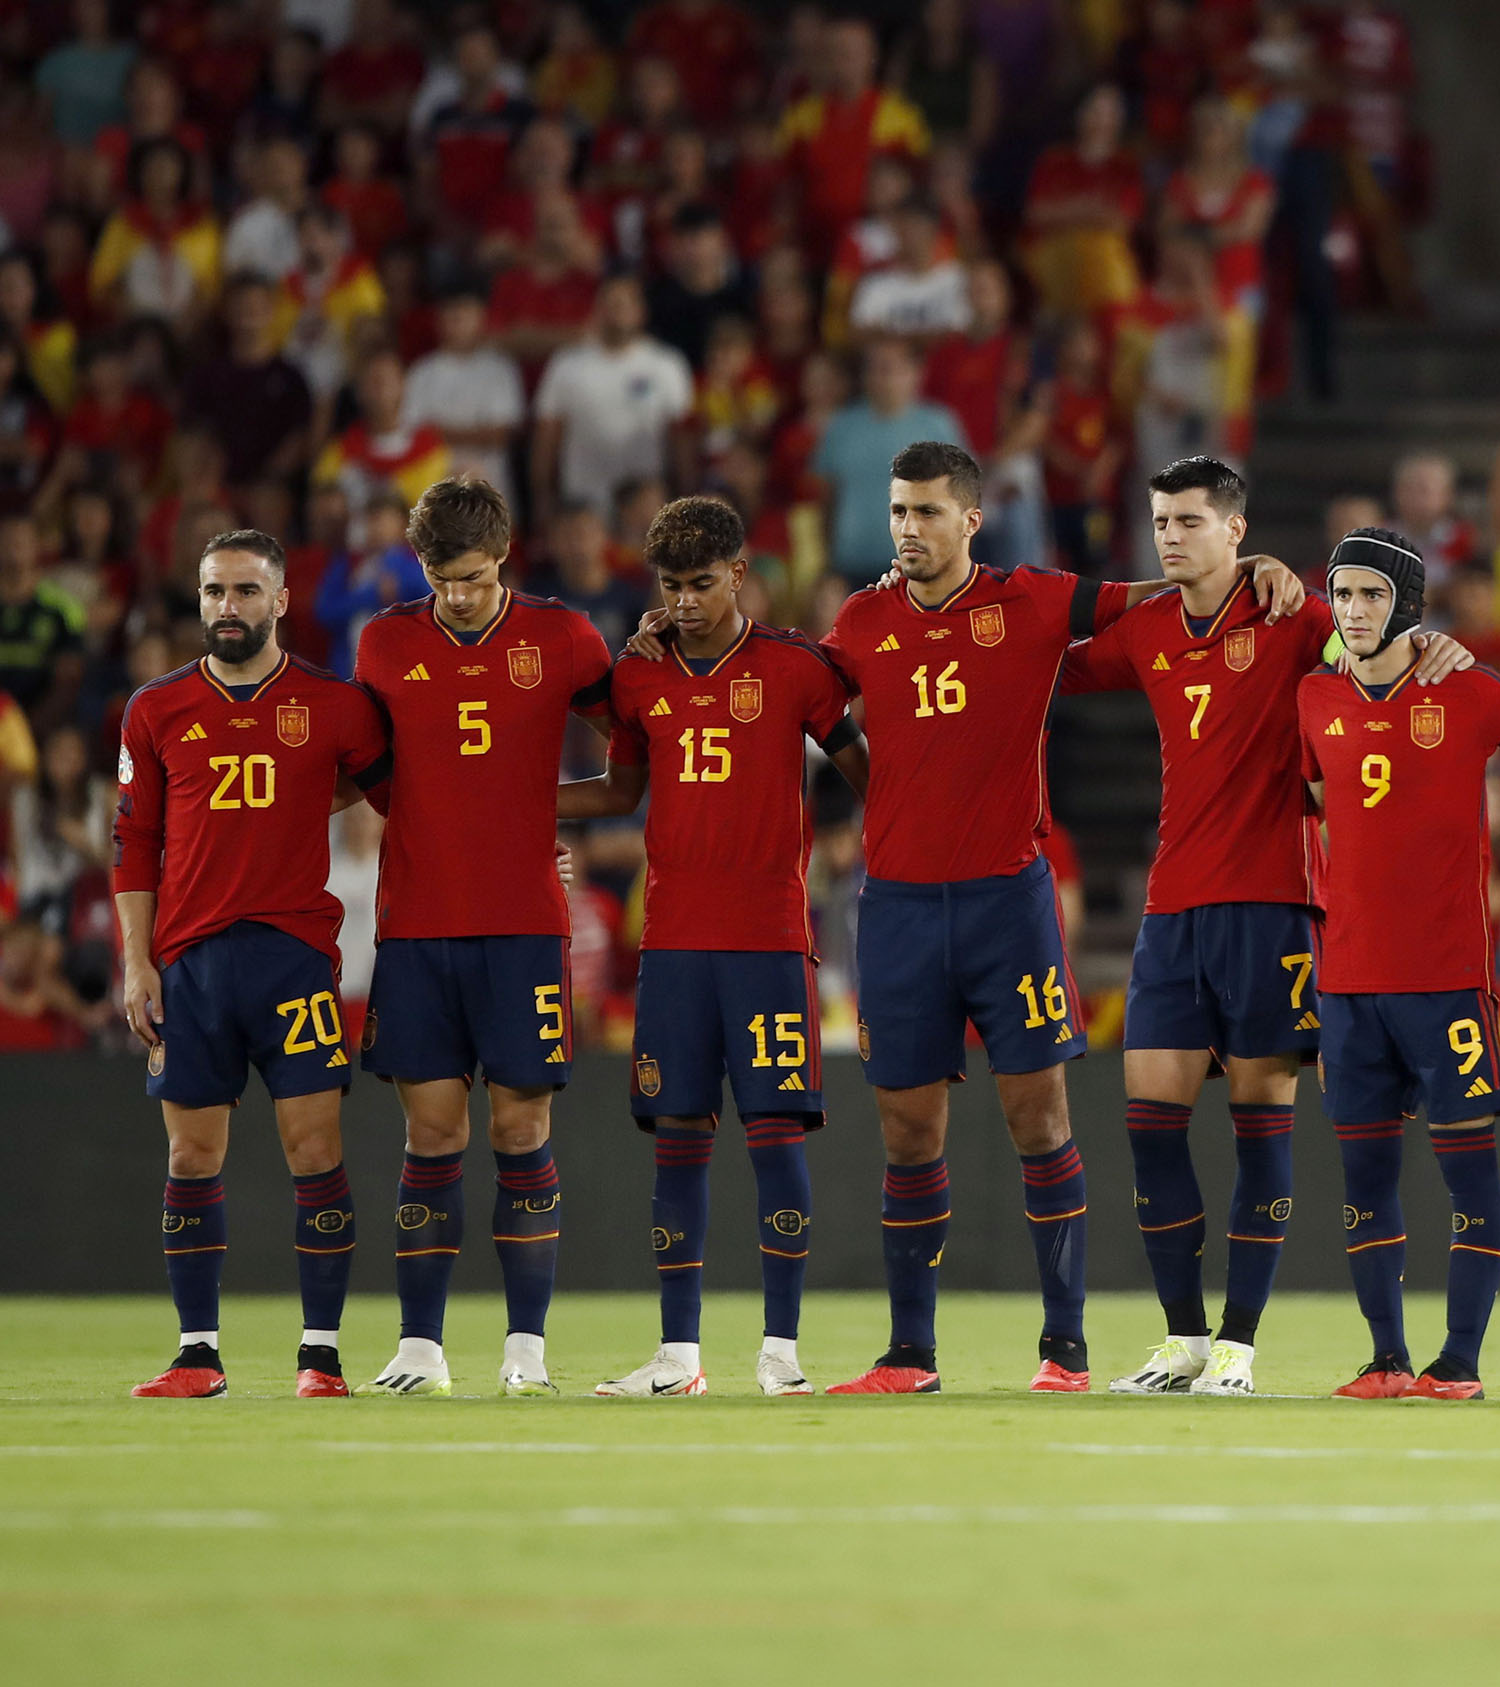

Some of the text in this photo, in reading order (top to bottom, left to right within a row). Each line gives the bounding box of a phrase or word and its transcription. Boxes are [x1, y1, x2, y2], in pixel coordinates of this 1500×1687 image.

[911, 661, 967, 718] 16
[1184, 683, 1211, 740] 7
[457, 700, 492, 755] 5
[678, 727, 733, 783] 15
[208, 753, 276, 811] 20
[1360, 753, 1392, 810] 9
[1015, 966, 1069, 1030] 16
[1280, 951, 1314, 1009] 7
[275, 989, 344, 1056] 20
[533, 983, 565, 1041] 5
[747, 1012, 810, 1069] 15
[1446, 1017, 1485, 1076] 9
